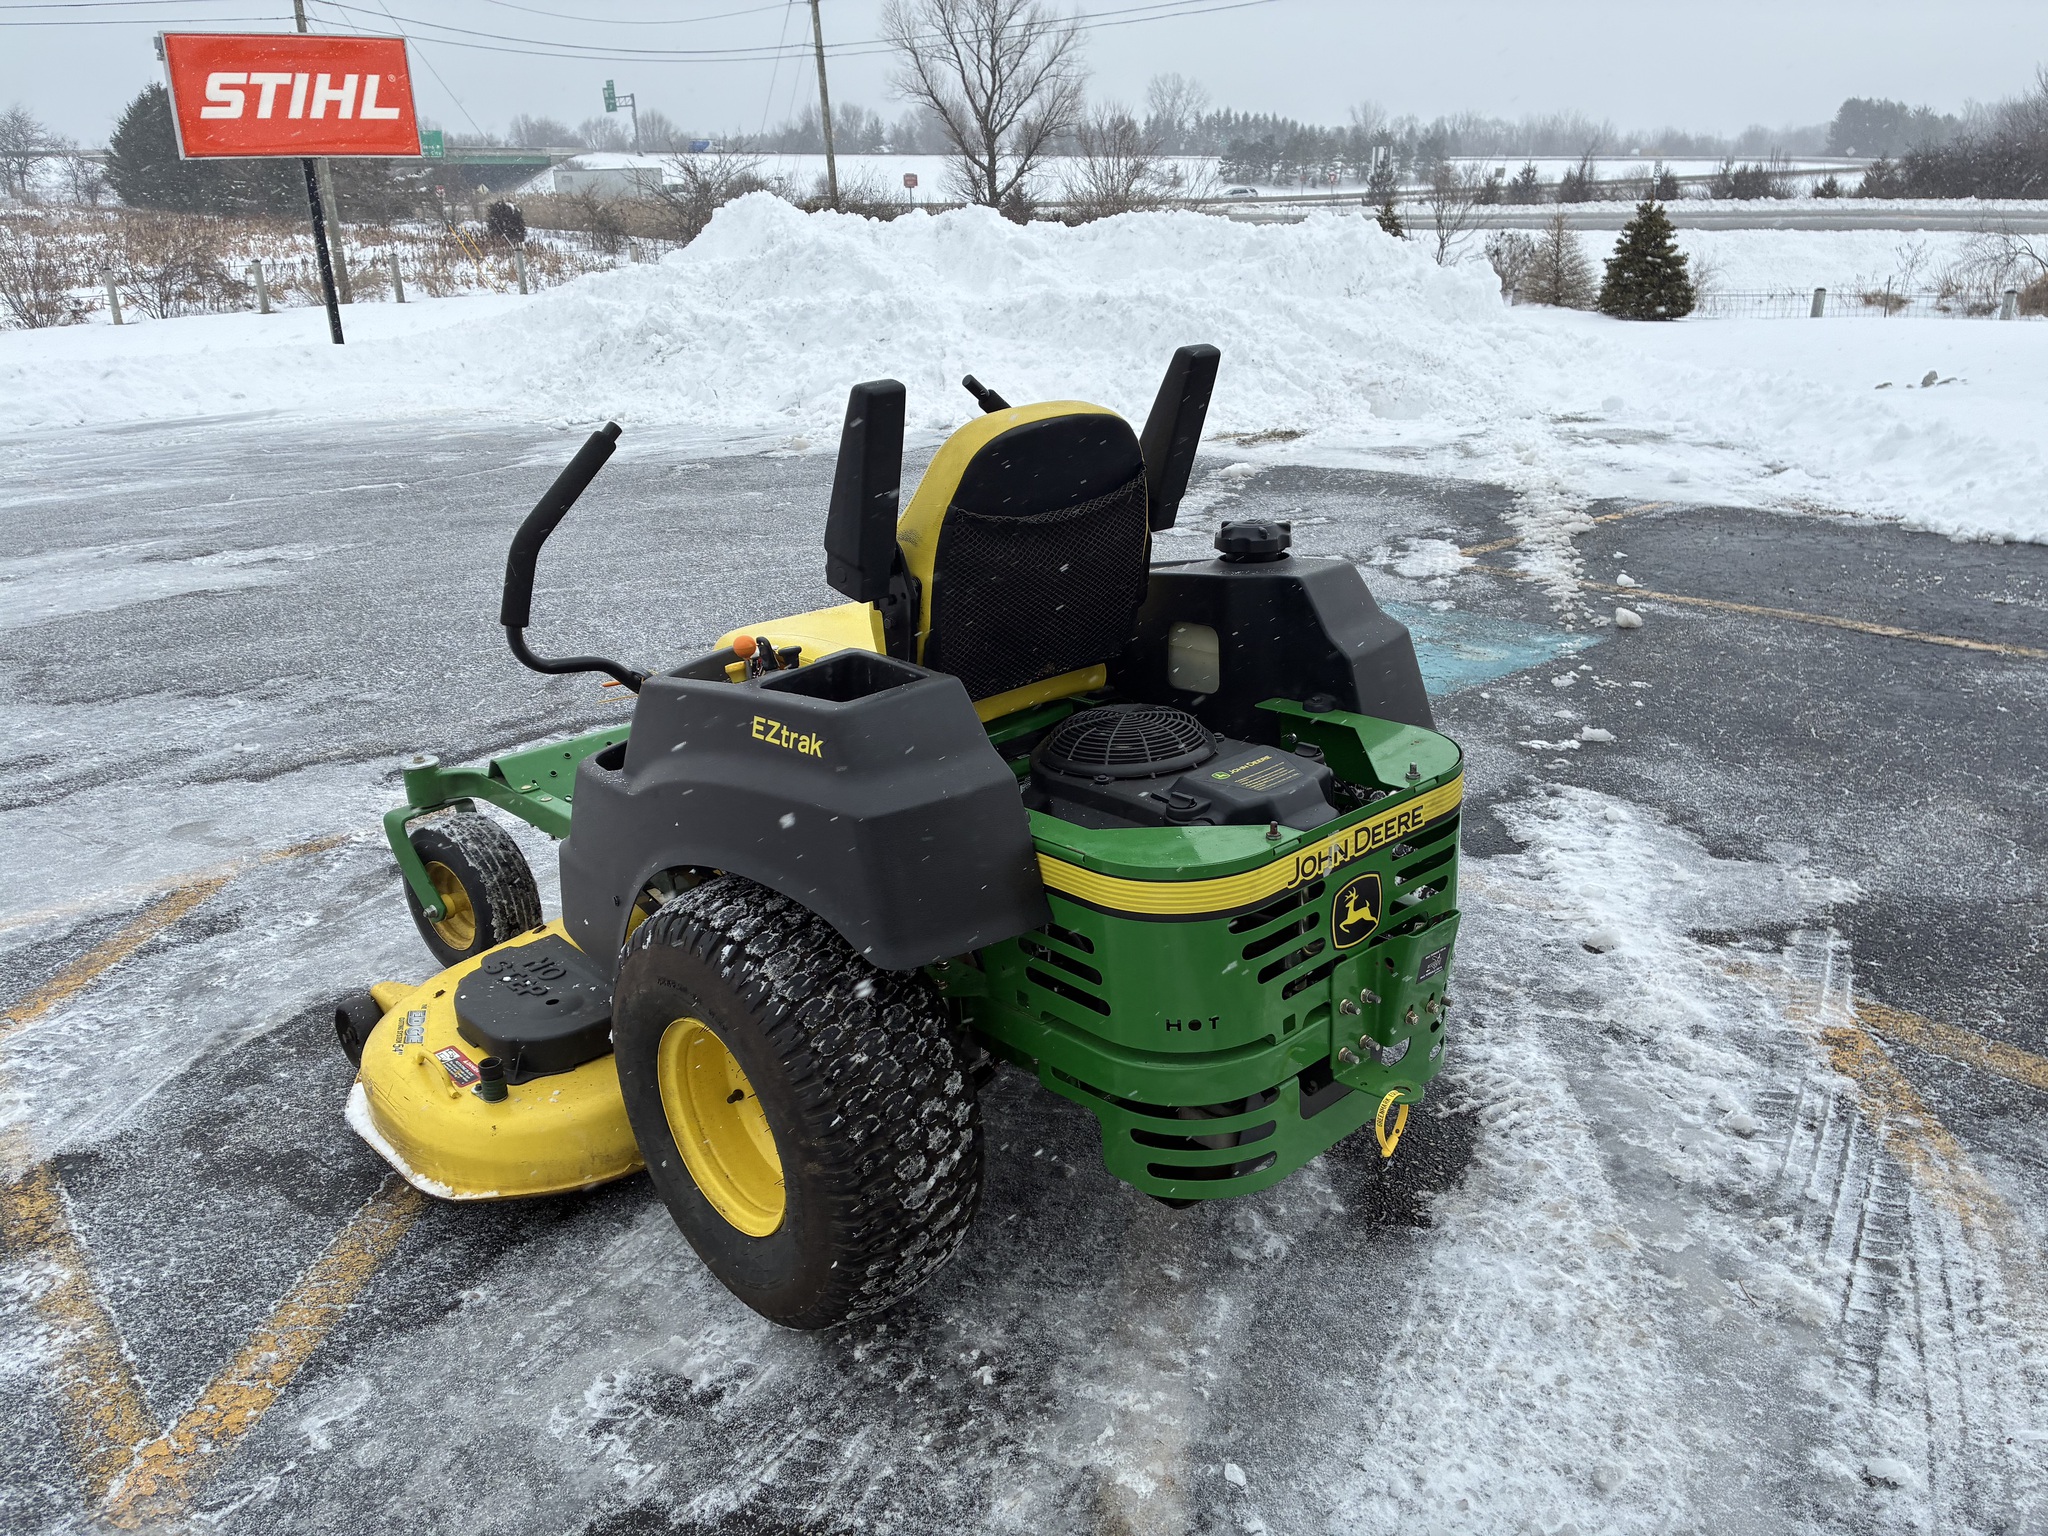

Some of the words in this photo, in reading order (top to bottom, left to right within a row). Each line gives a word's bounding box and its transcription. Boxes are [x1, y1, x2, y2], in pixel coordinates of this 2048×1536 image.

[200, 72, 400, 119] STIHL
[752, 715, 824, 758] EZtrak
[1287, 839, 1349, 887] JOHN
[1354, 805, 1425, 855] DEERE
[403, 1010, 426, 1044] EDGE
[1165, 1016, 1220, 1032] HOT
